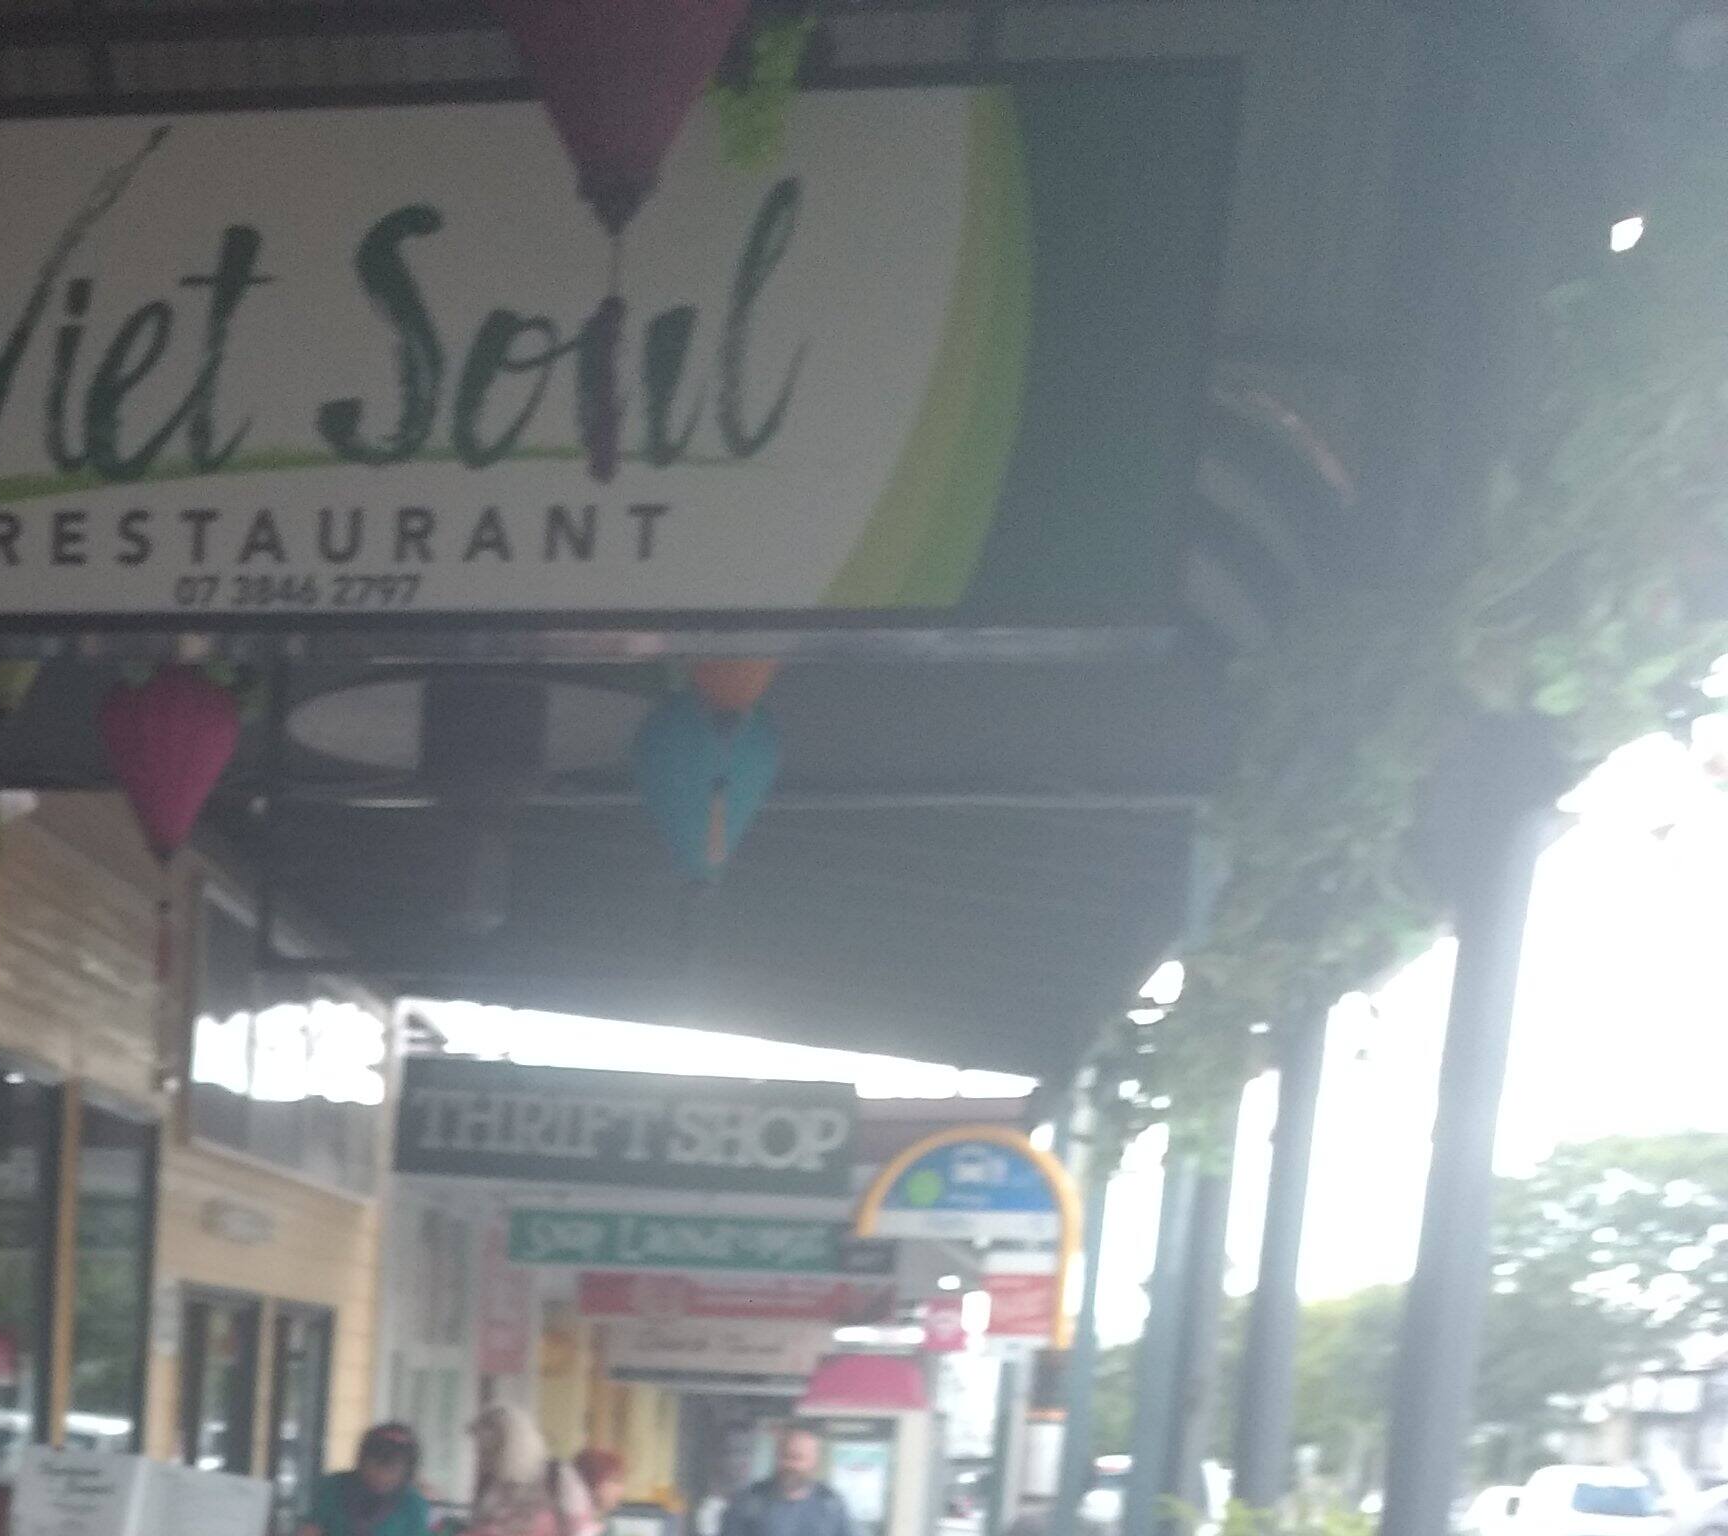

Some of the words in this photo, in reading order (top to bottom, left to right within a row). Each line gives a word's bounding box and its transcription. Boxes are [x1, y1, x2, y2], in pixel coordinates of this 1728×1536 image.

[316, 172, 810, 470] Soul
[174, 574, 220, 606] 07
[408, 1088, 669, 1160] THRIFT
[669, 1101, 852, 1172] SHOP
